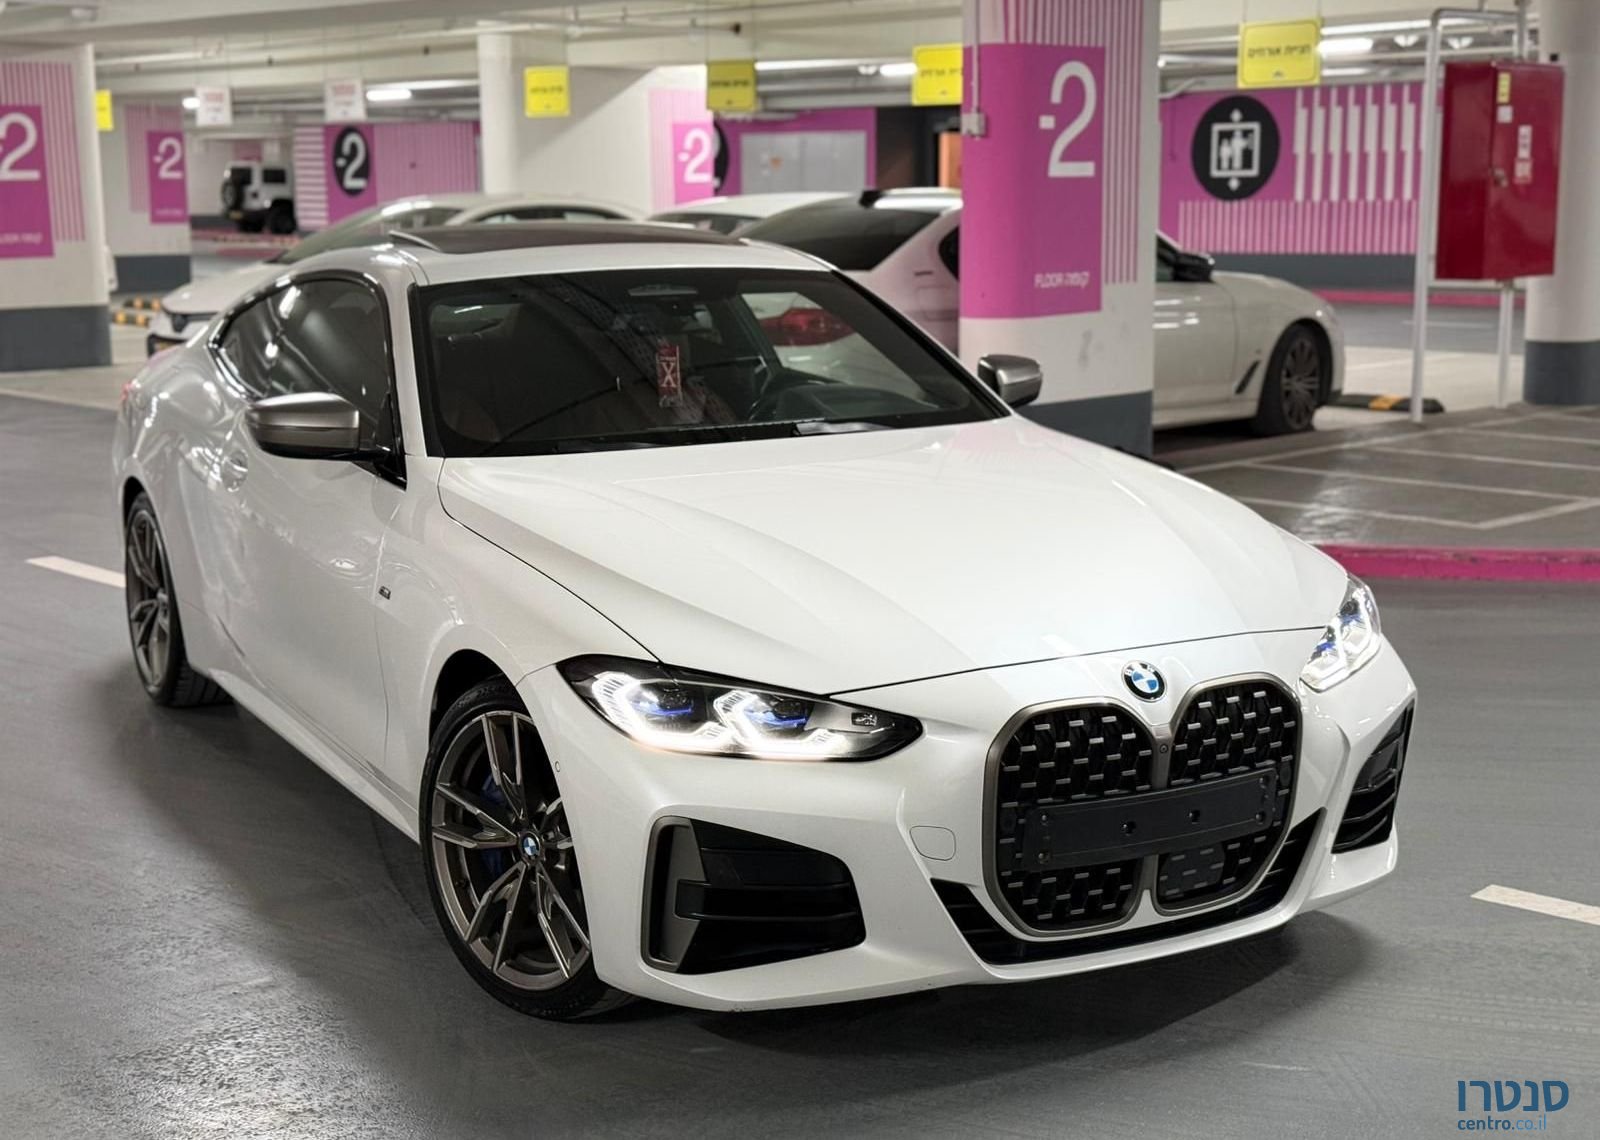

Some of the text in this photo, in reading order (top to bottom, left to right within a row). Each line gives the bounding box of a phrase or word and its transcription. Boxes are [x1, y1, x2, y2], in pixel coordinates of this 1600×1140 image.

[1039, 60, 1097, 178] -2
[152, 136, 184, 180] -2
[336, 132, 367, 190] -2
[678, 127, 712, 183] -2
